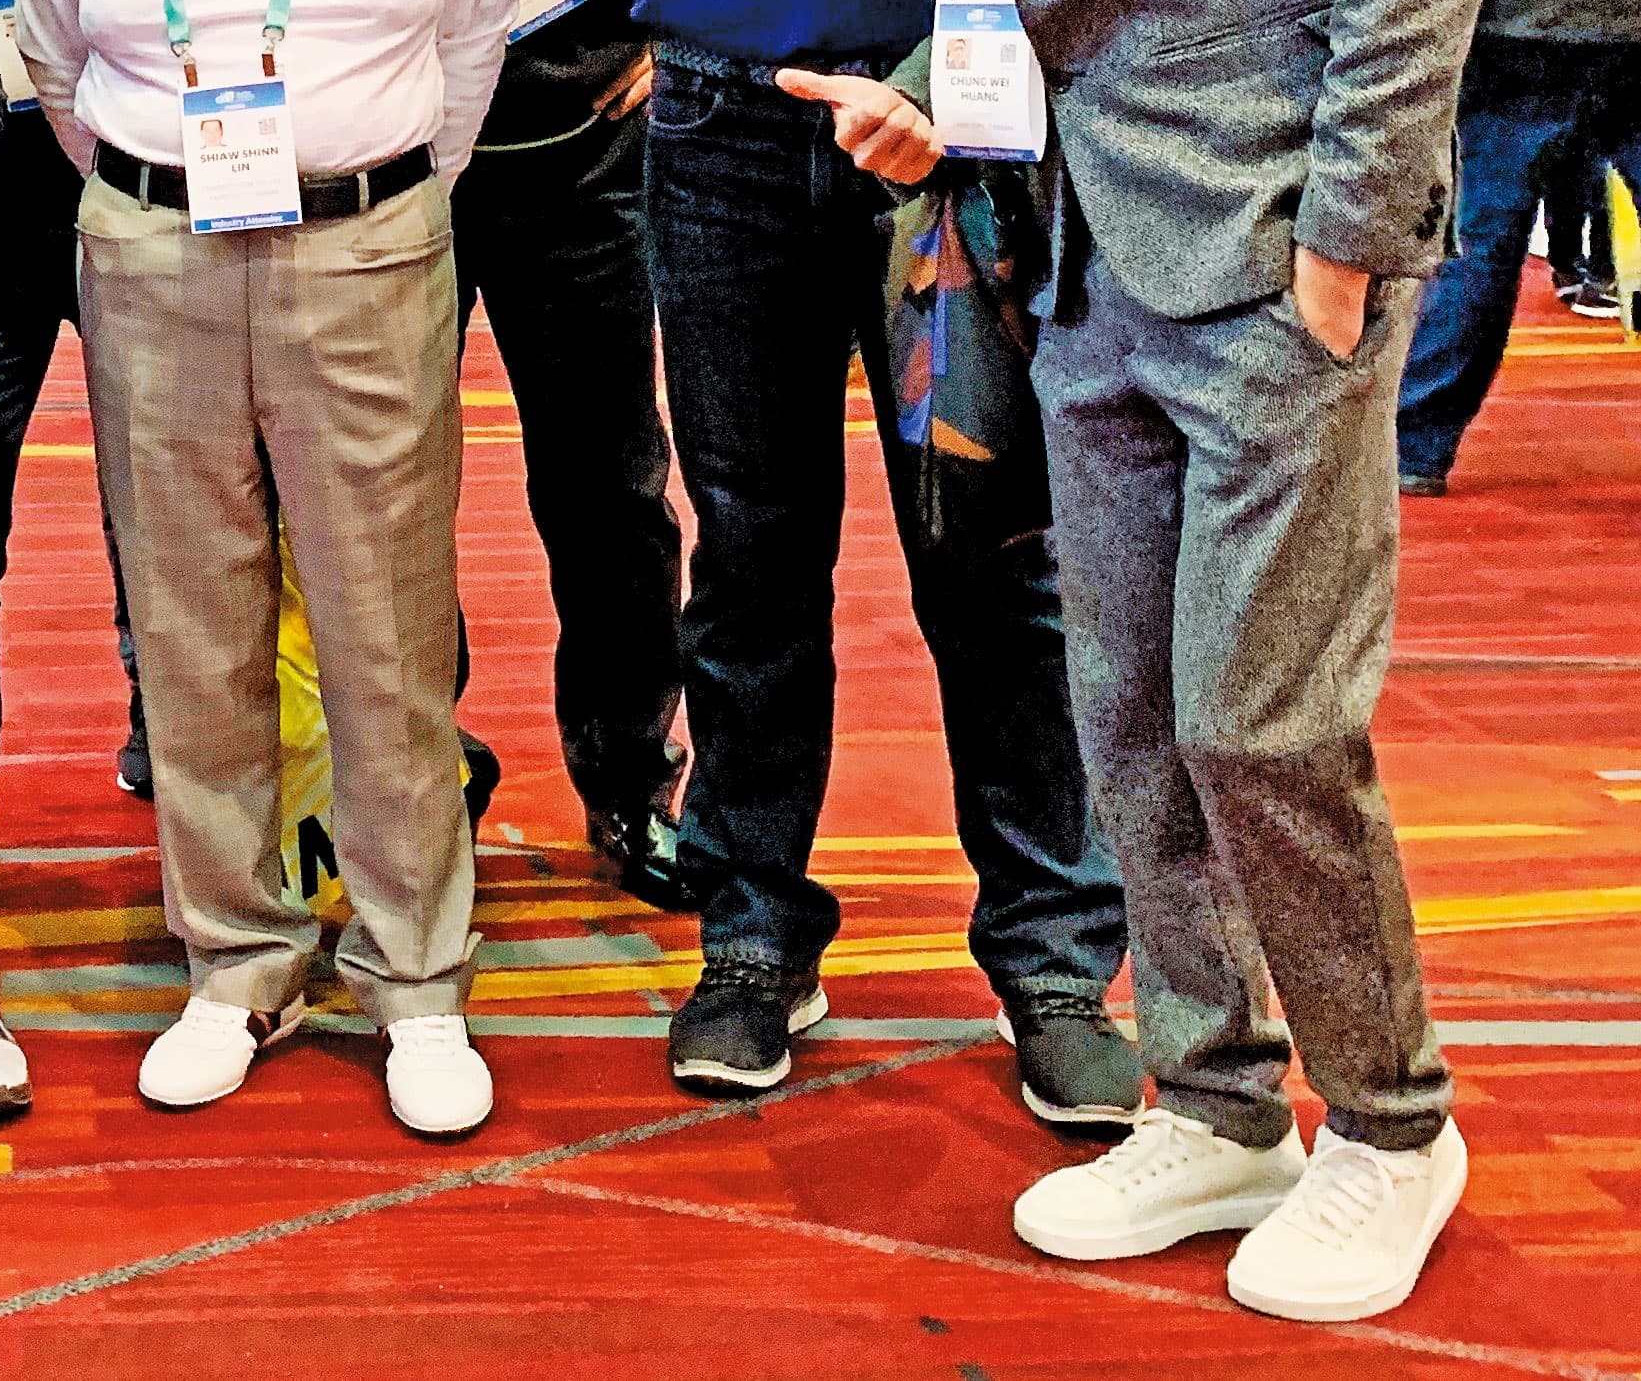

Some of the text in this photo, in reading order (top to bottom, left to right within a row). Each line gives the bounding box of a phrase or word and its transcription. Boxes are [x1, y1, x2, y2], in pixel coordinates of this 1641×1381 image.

[950, 76, 1010, 87] CHUNG WEI
[961, 91, 999, 102] HUANG
[200, 146, 279, 163] SHIAW SHINN
[232, 163, 250, 173] LIN
